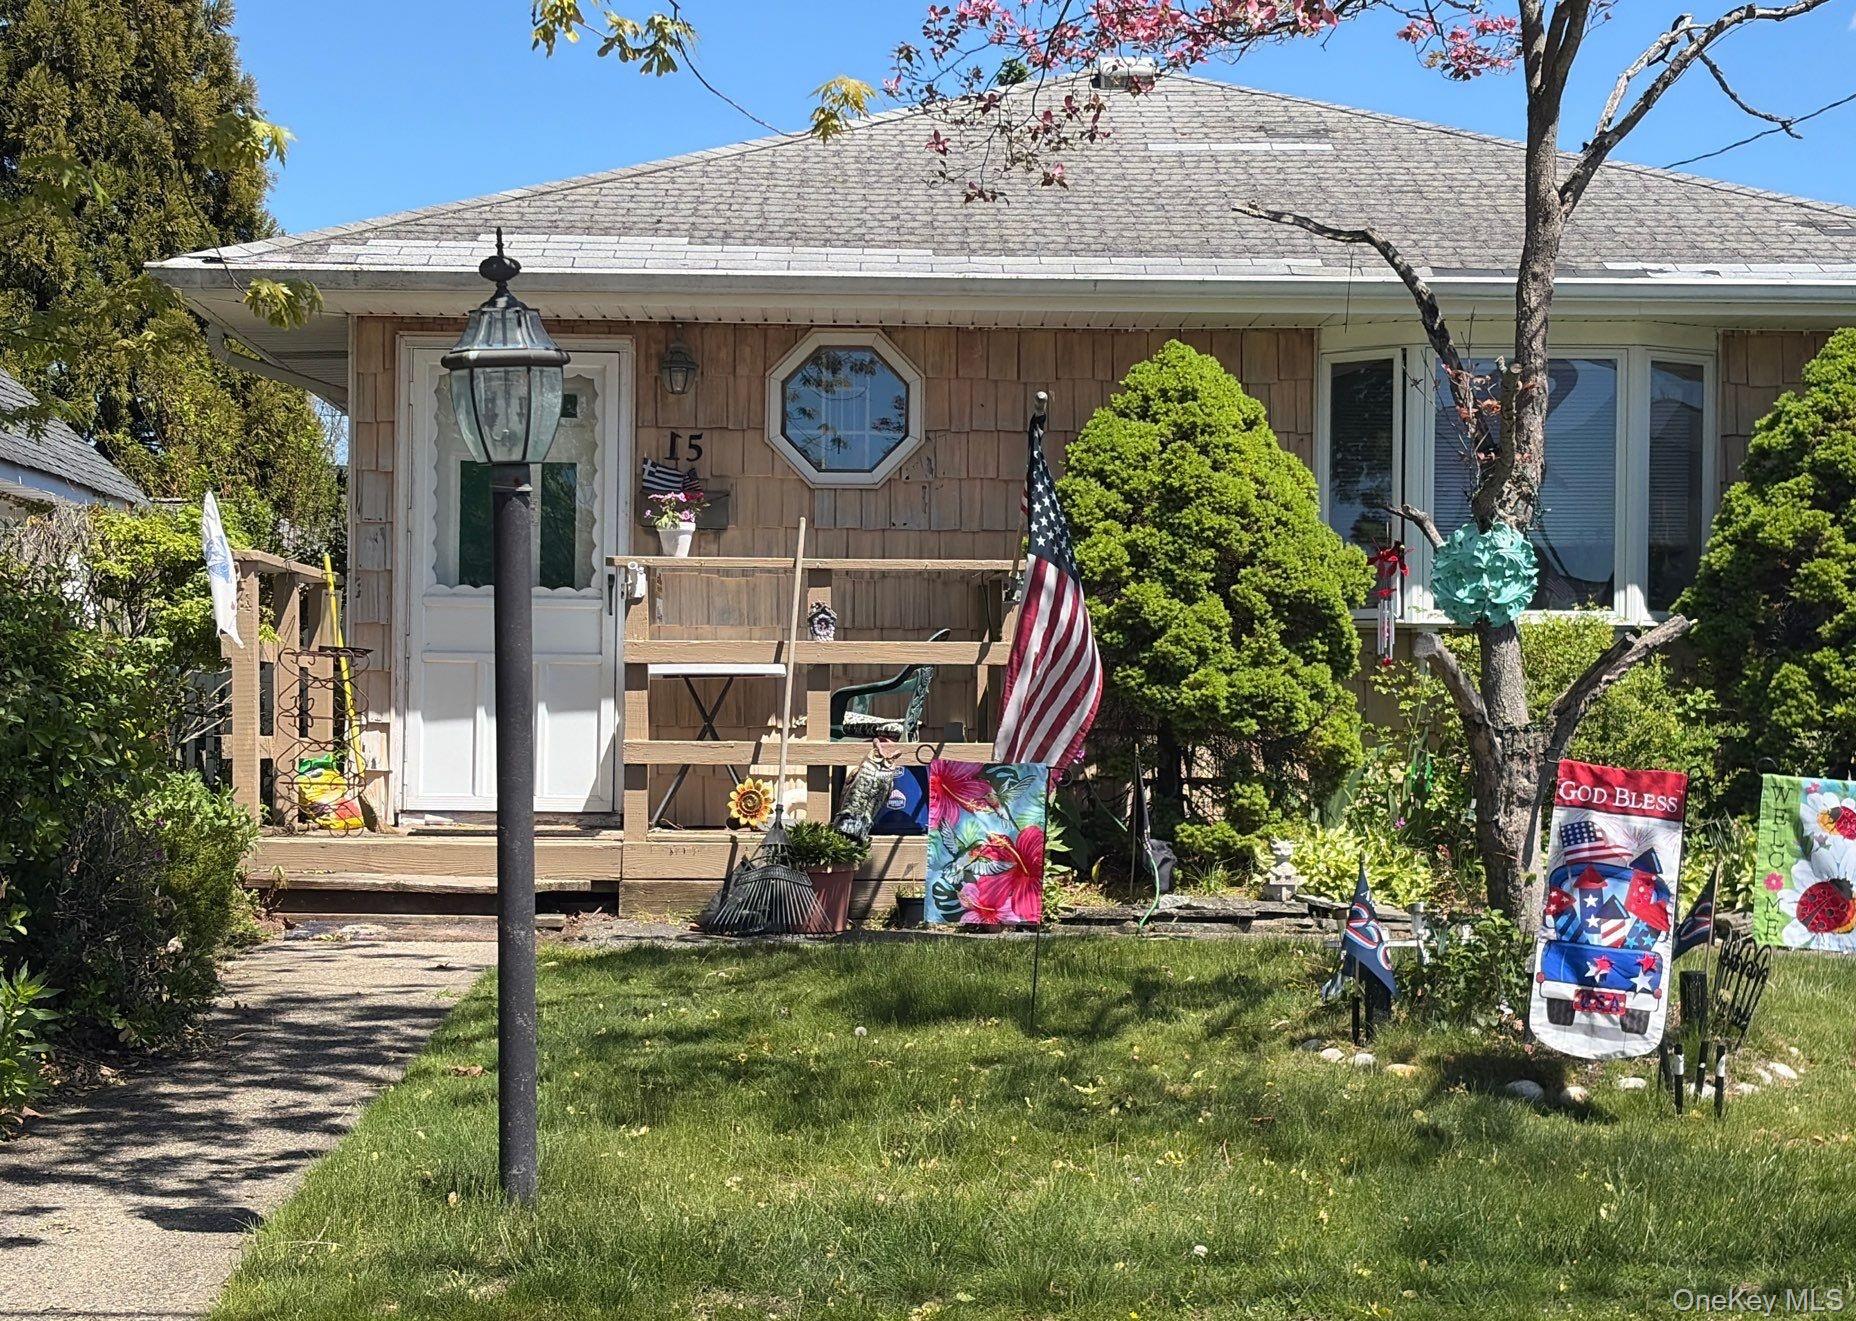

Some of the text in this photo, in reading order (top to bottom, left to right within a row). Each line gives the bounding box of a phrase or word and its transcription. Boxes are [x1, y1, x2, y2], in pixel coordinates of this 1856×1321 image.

[664, 431, 704, 462] 15
[1559, 780, 1679, 813] GOD BLESS
